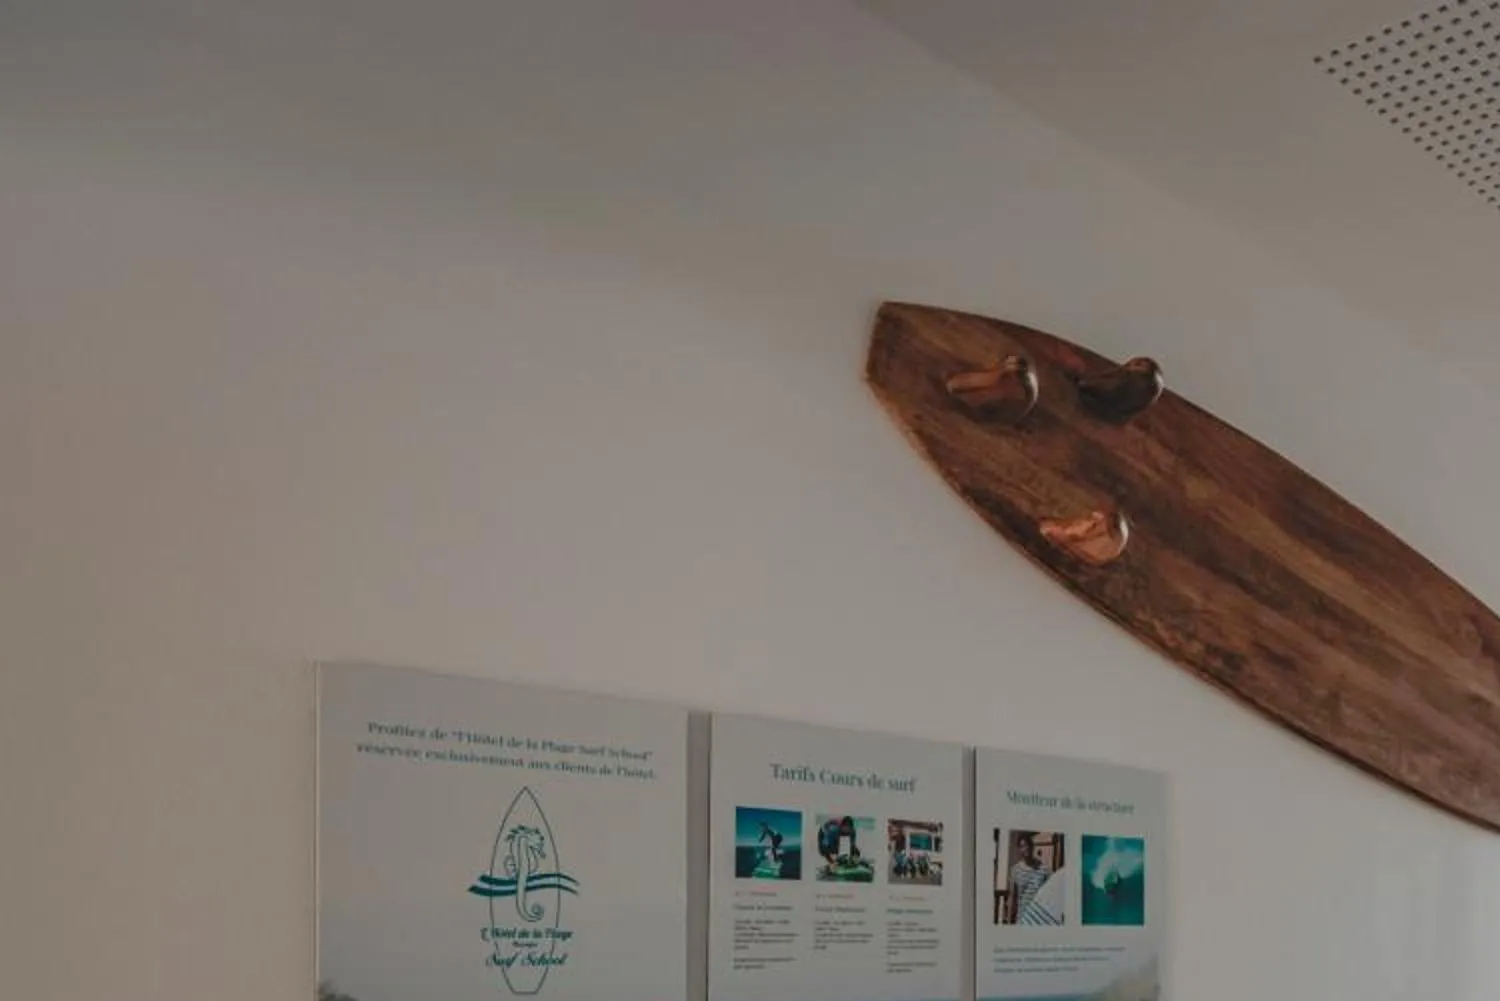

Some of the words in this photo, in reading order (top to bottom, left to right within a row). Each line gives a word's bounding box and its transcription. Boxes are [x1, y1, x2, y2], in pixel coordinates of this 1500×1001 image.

[430, 727, 446, 740] de
[504, 736, 521, 749] de
[769, 763, 815, 783] Tarifs
[819, 768, 863, 787] Cours
[867, 774, 885, 788] de
[888, 776, 918, 793] surf
